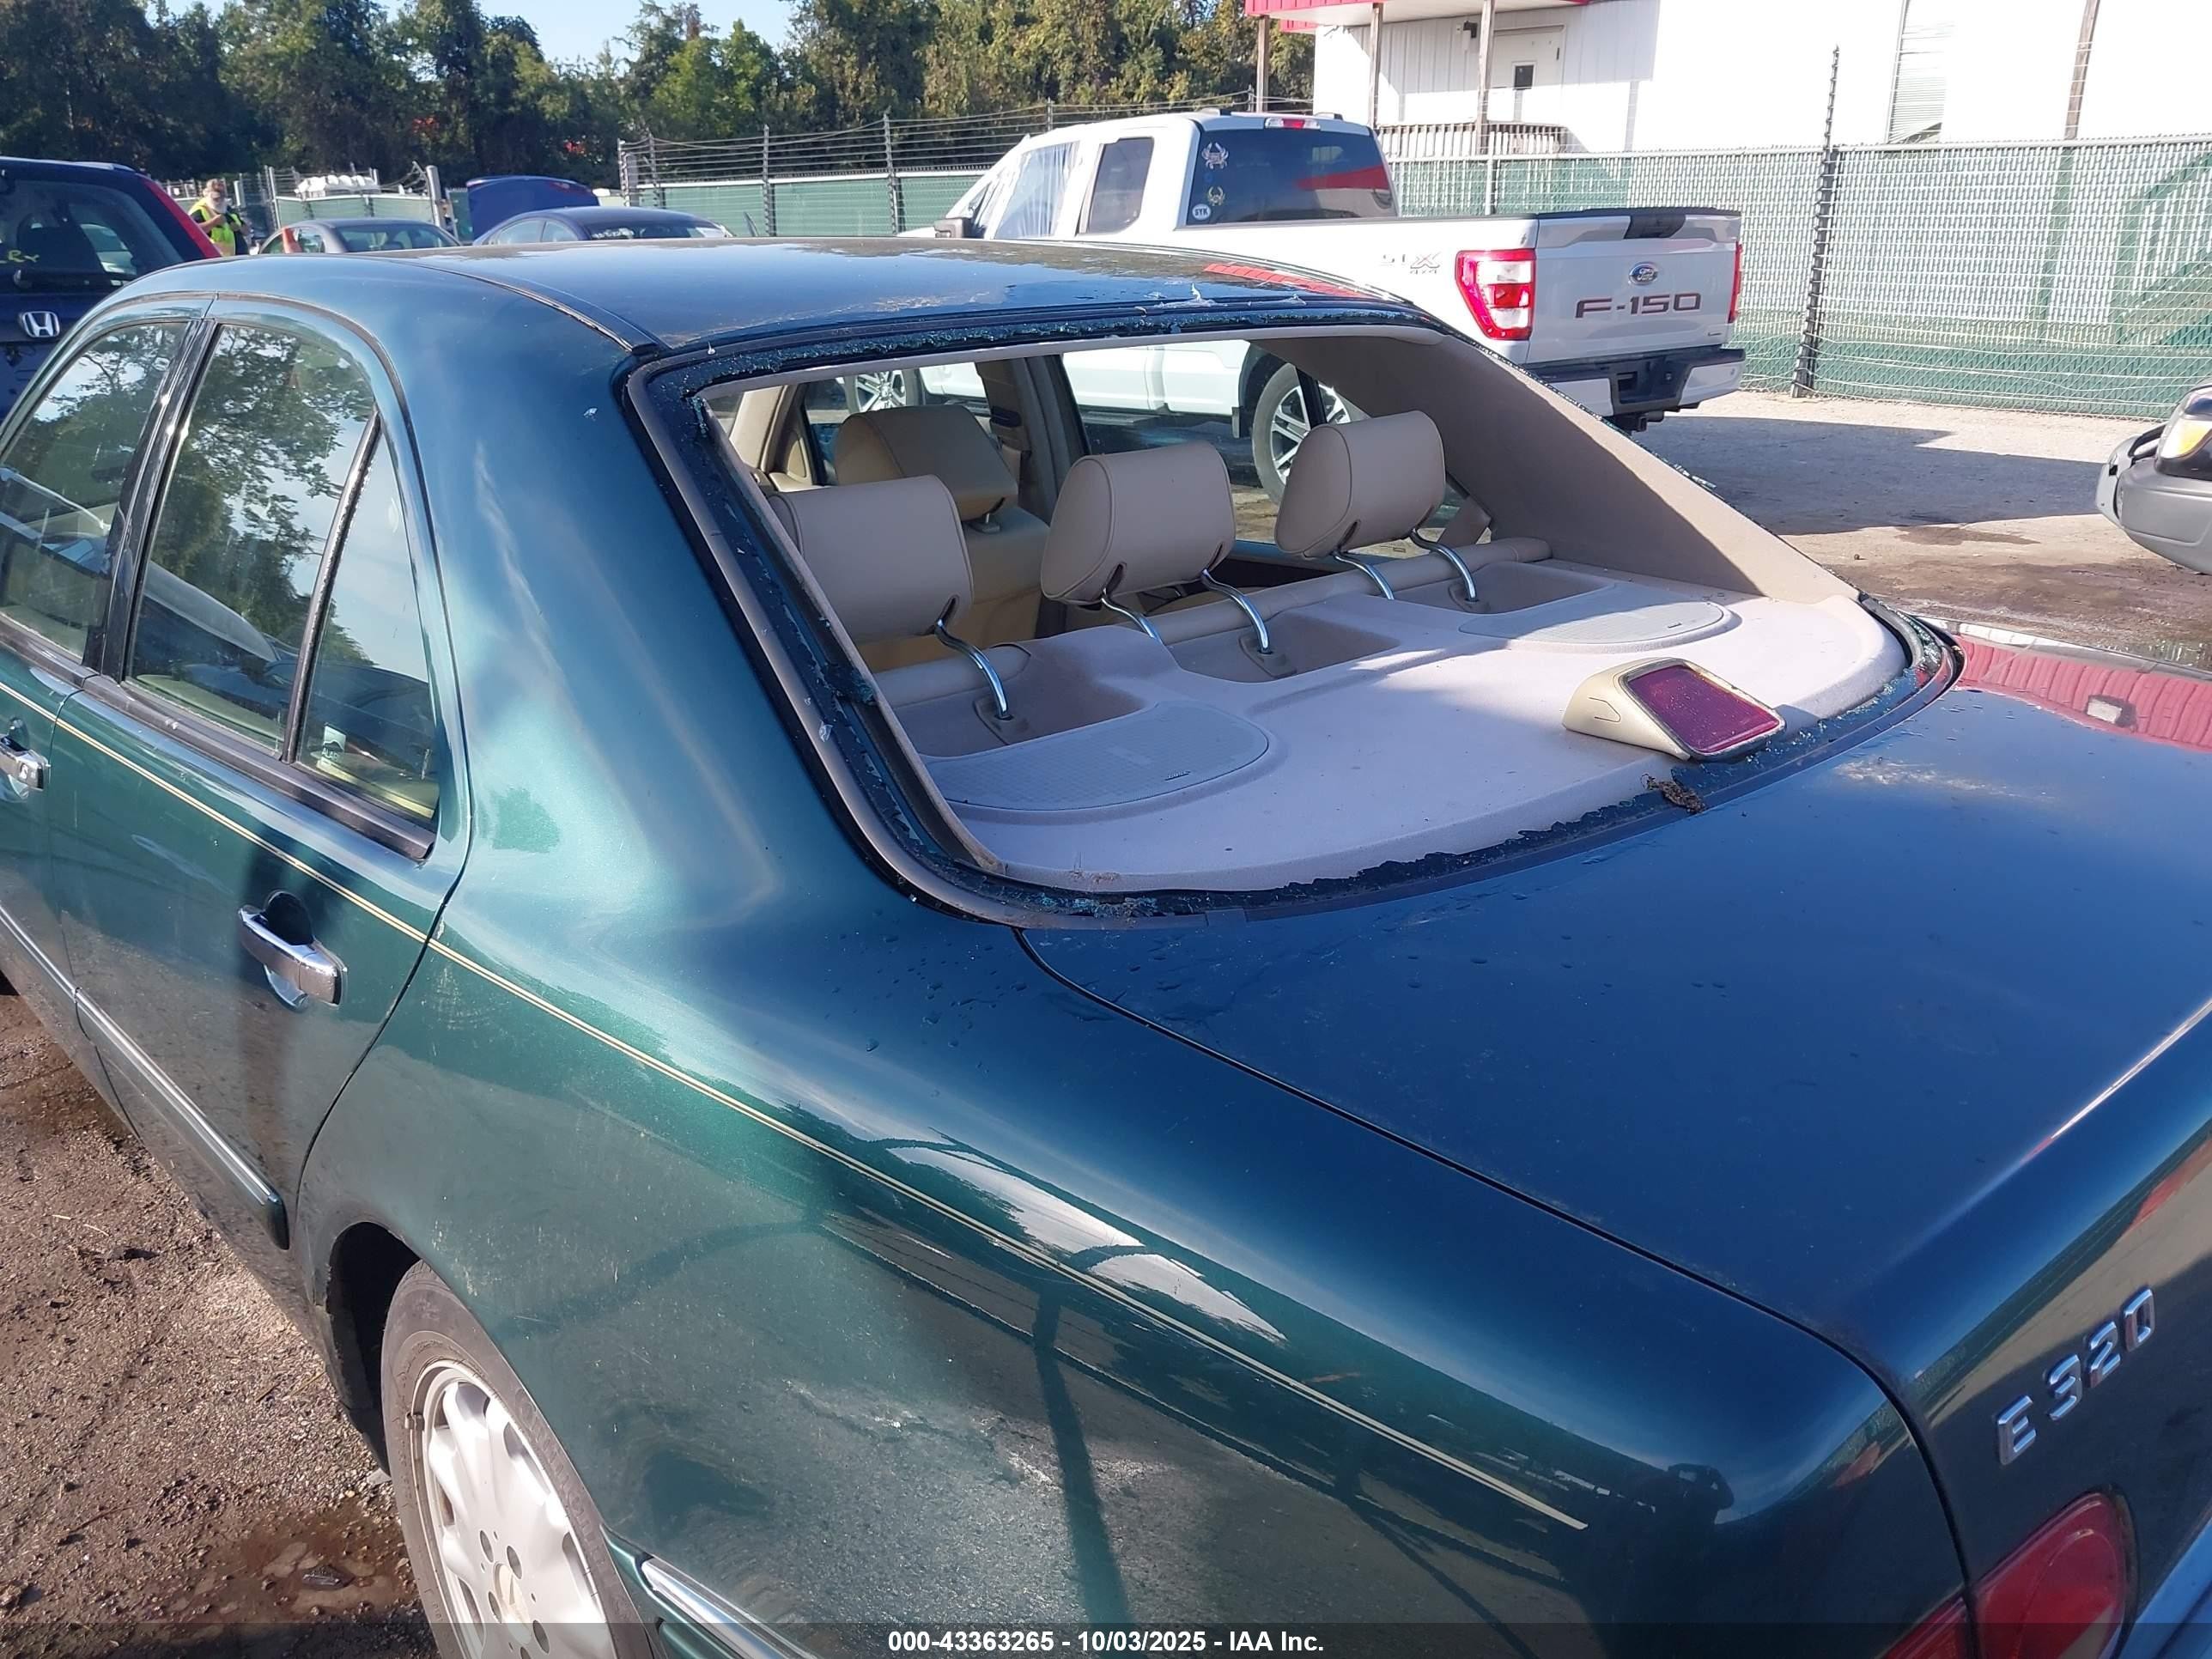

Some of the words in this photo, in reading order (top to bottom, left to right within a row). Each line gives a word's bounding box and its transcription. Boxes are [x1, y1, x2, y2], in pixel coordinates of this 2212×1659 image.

[1575, 292, 1701, 319] F-150
[1997, 1395, 2037, 1465] E
[2046, 1287, 2155, 1422] 320
